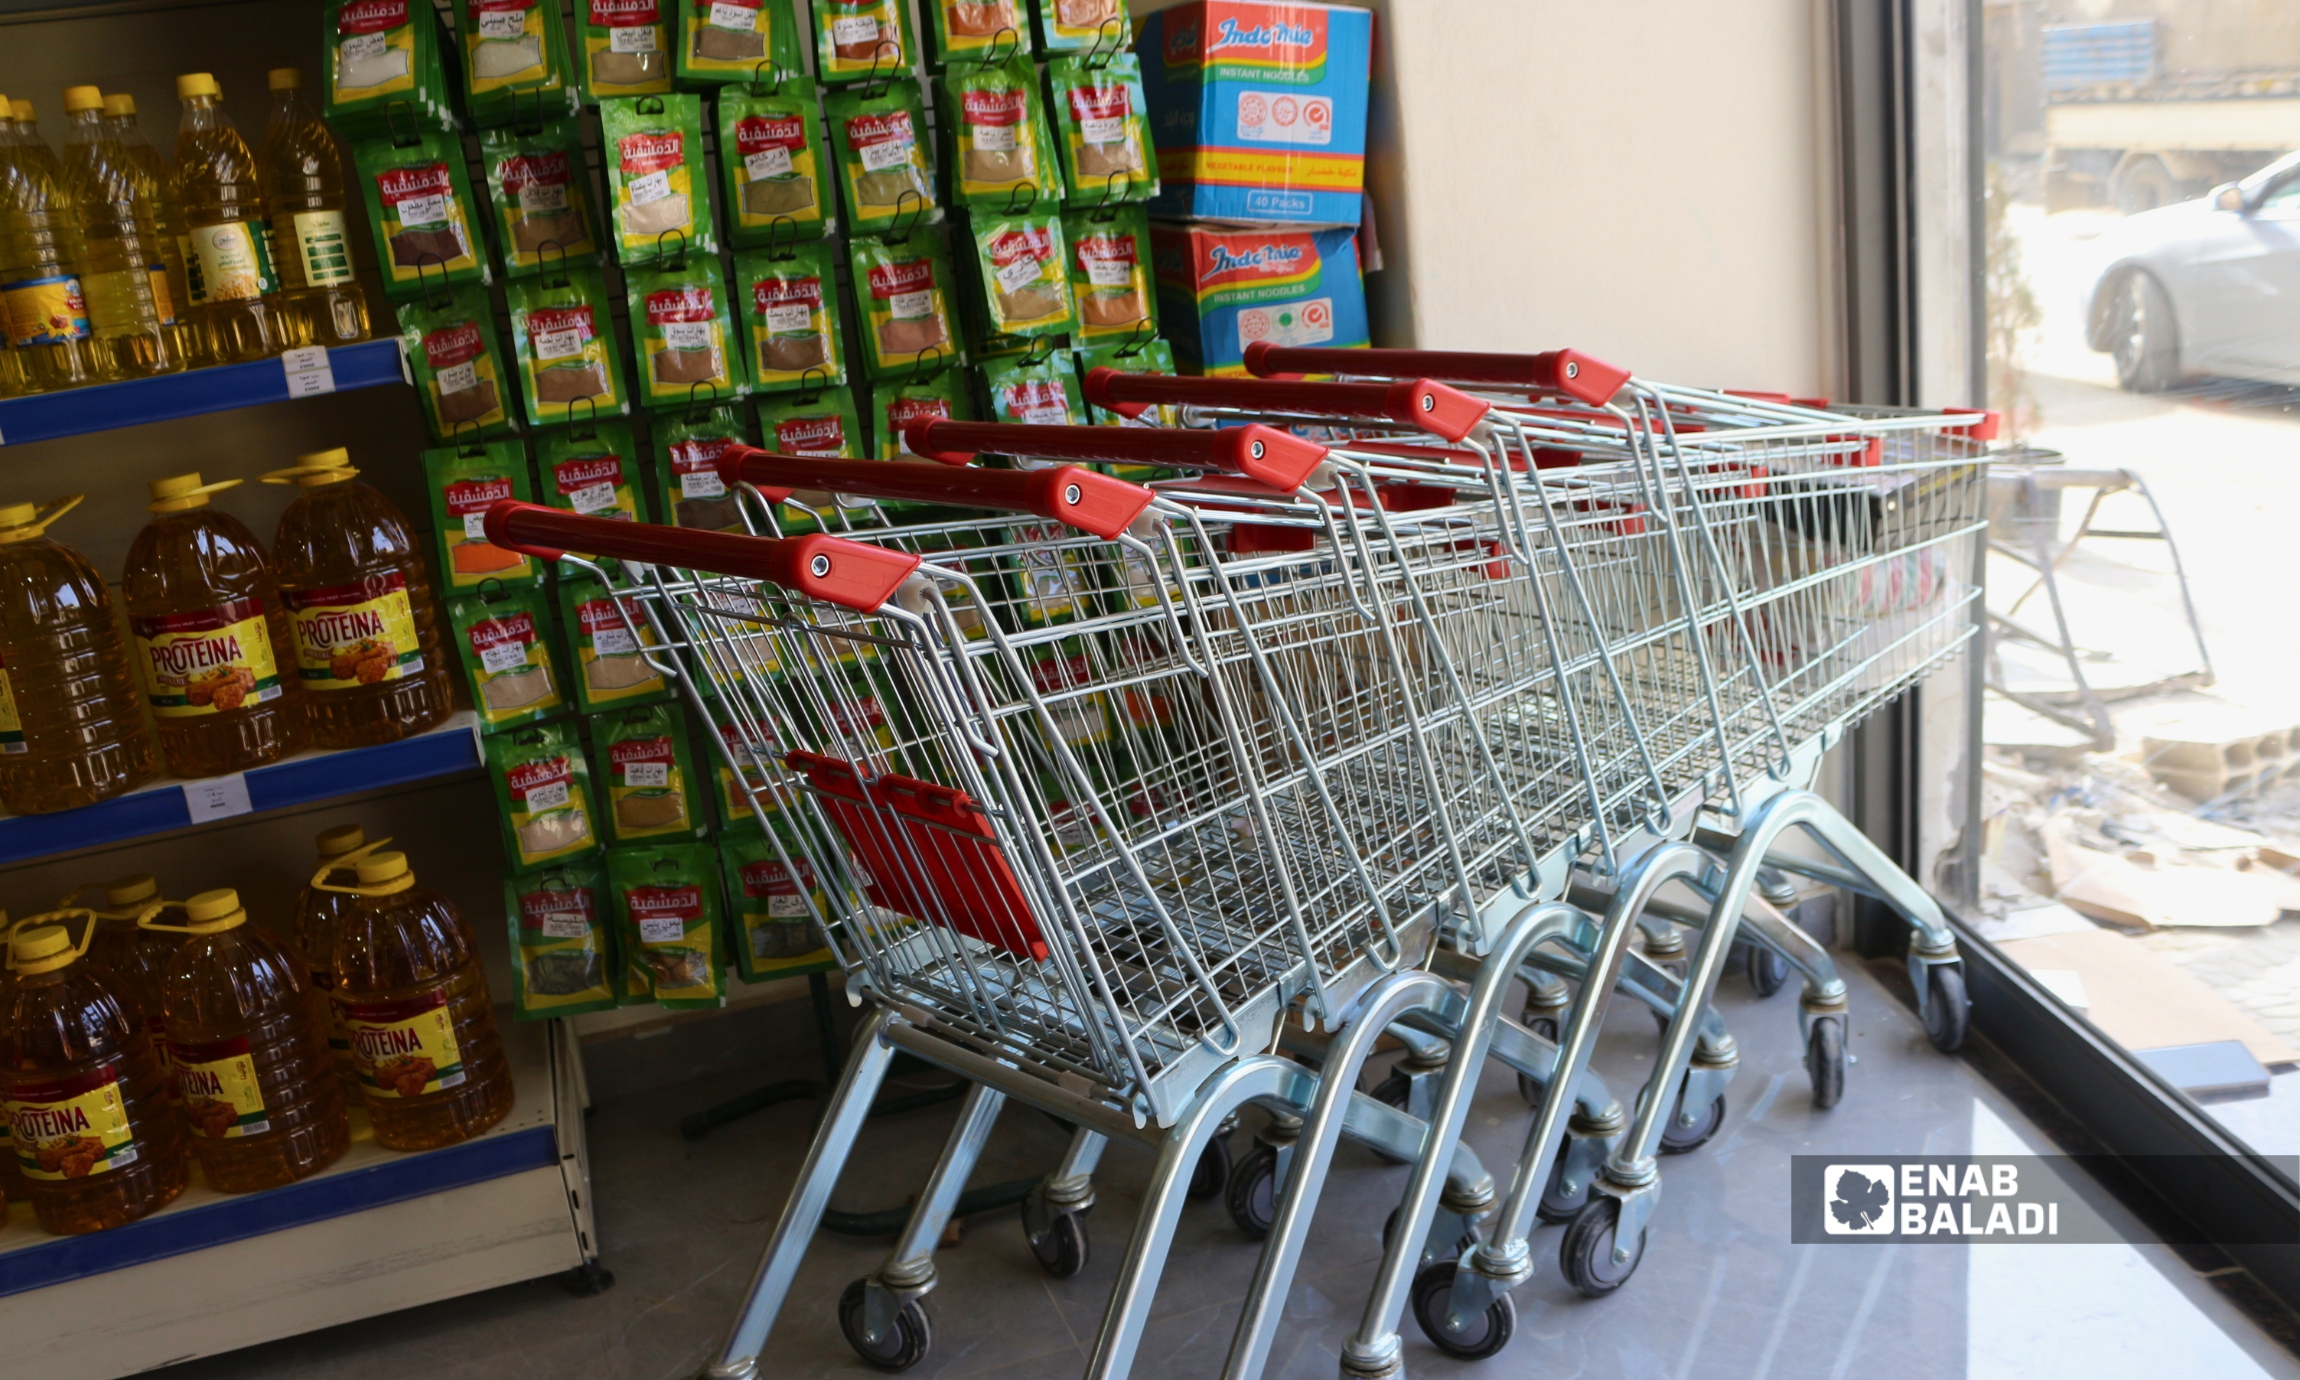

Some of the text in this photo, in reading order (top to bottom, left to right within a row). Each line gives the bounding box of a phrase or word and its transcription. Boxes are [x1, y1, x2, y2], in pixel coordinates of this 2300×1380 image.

[1219, 67, 1310, 83] INSTANT NOODLES
[738, 122, 801, 145] الدمشقية
[1206, 161, 1253, 172] VEGETABLE
[1255, 195, 1306, 210] 40 Packs
[1214, 284, 1305, 303] INSTANT NOODLES
[558, 461, 619, 484] الدمشقية
[448, 484, 510, 506] الدمشقية
[296, 608, 385, 649] PROTEINA
[149, 634, 243, 675] PROTEINA
[524, 893, 590, 917] الدمشقية
[630, 892, 698, 912] الدمشقية
